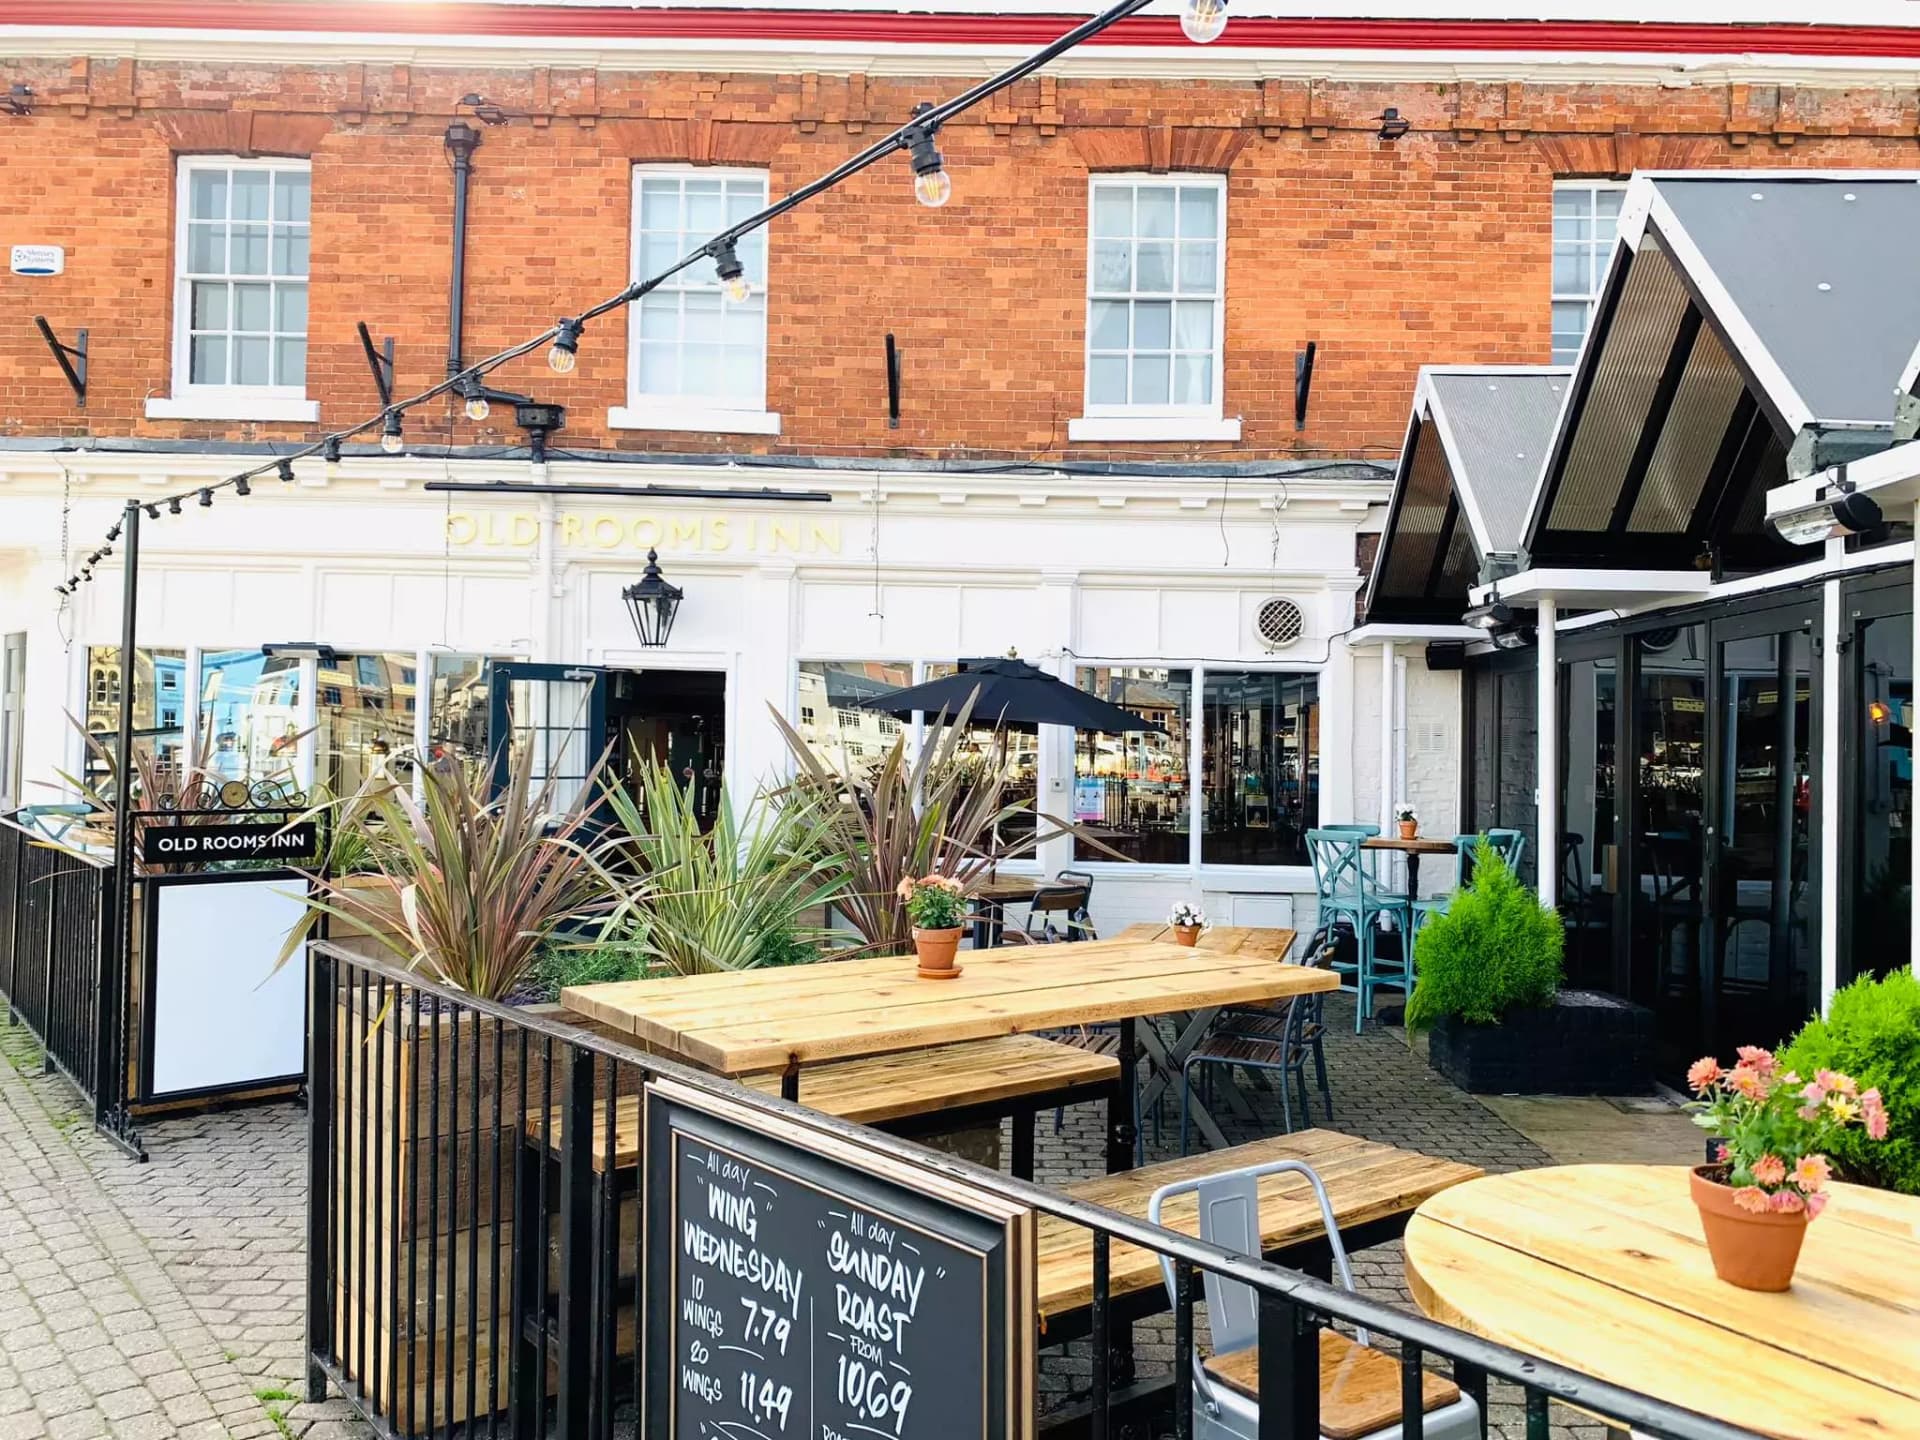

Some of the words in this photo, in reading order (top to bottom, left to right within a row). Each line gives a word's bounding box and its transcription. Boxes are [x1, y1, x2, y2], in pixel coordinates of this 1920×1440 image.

[447, 511, 539, 547] OLD
[561, 511, 731, 552] ROOMS
[747, 516, 842, 554] INN
[158, 837, 198, 852] OLD
[202, 834, 266, 850] ROOMS
[271, 833, 305, 848] INN
[706, 1151, 720, 1176] All
[721, 1160, 750, 1192] day
[708, 1182, 758, 1243] WING
[850, 1210, 864, 1238] All
[867, 1221, 896, 1254] day
[683, 1219, 803, 1321] WEDNESDAY
[691, 1274, 705, 1300] 10
[826, 1230, 926, 1317] SUNDAY
[683, 1298, 724, 1338] WINGS
[740, 1296, 792, 1357] 7.79
[835, 1282, 912, 1356] ROAST
[690, 1339, 710, 1365] 20
[849, 1334, 884, 1368] FROM
[682, 1364, 723, 1405] WINGS
[740, 1370, 793, 1433] 11.49
[837, 1353, 913, 1436] 10.69
